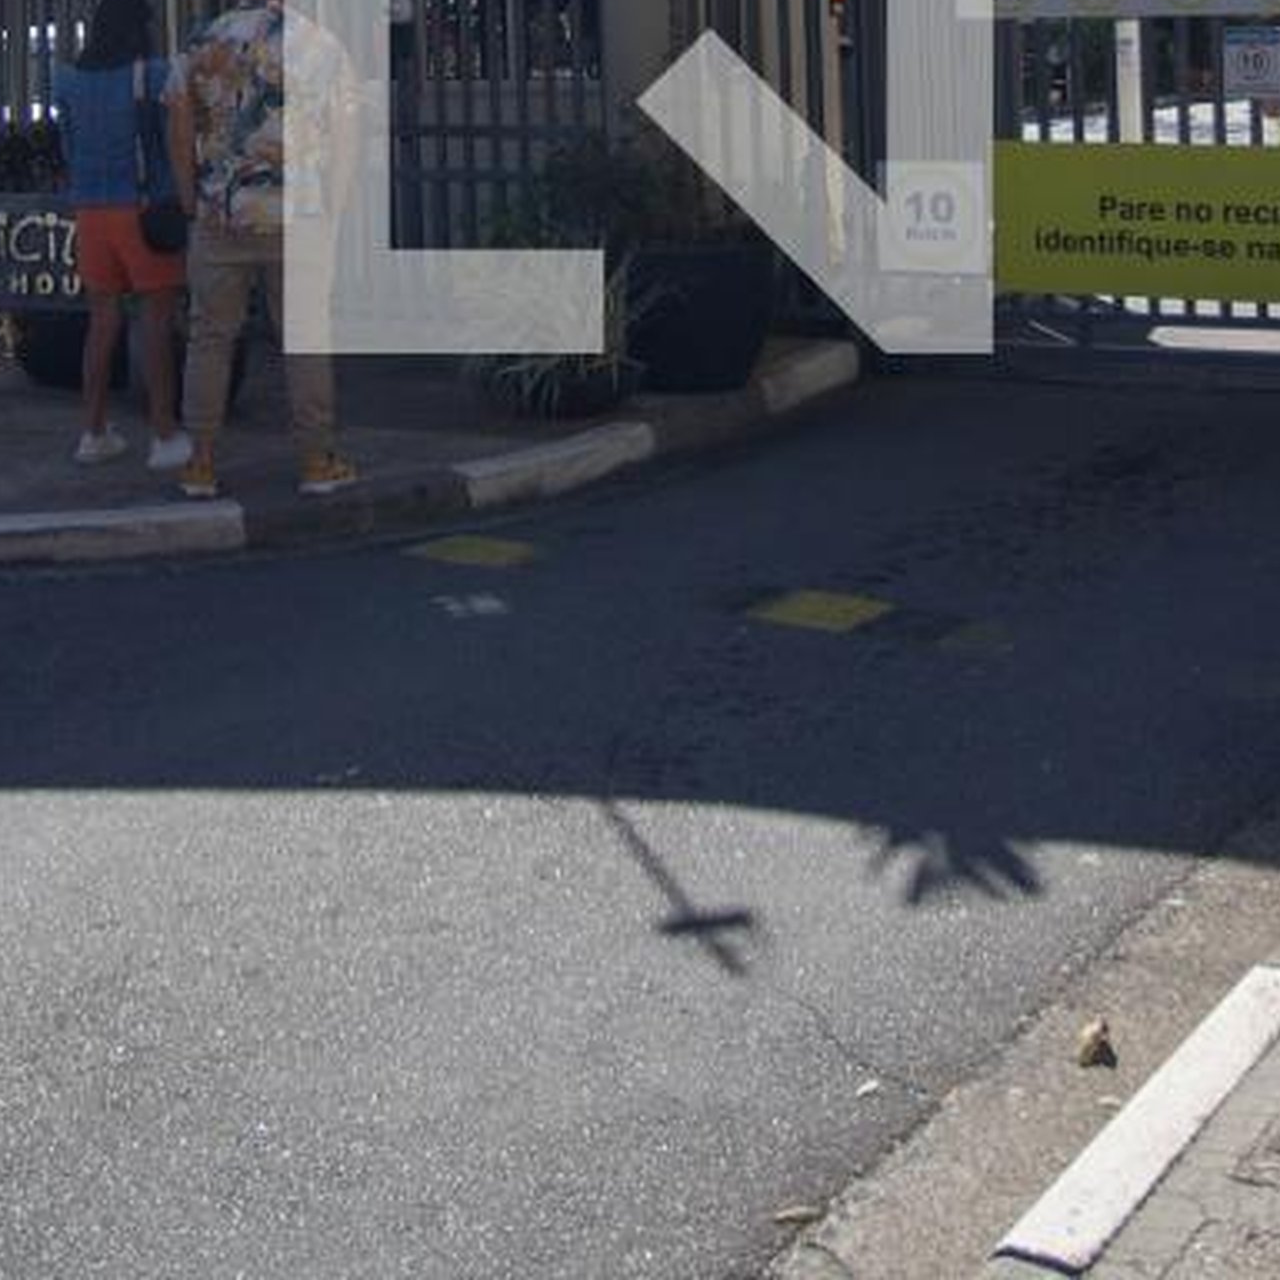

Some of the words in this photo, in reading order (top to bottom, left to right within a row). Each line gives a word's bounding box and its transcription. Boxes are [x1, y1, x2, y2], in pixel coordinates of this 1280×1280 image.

[904, 190, 956, 224] 10
[1098, 195, 1165, 222] Pare
[1175, 200, 1213, 224] no
